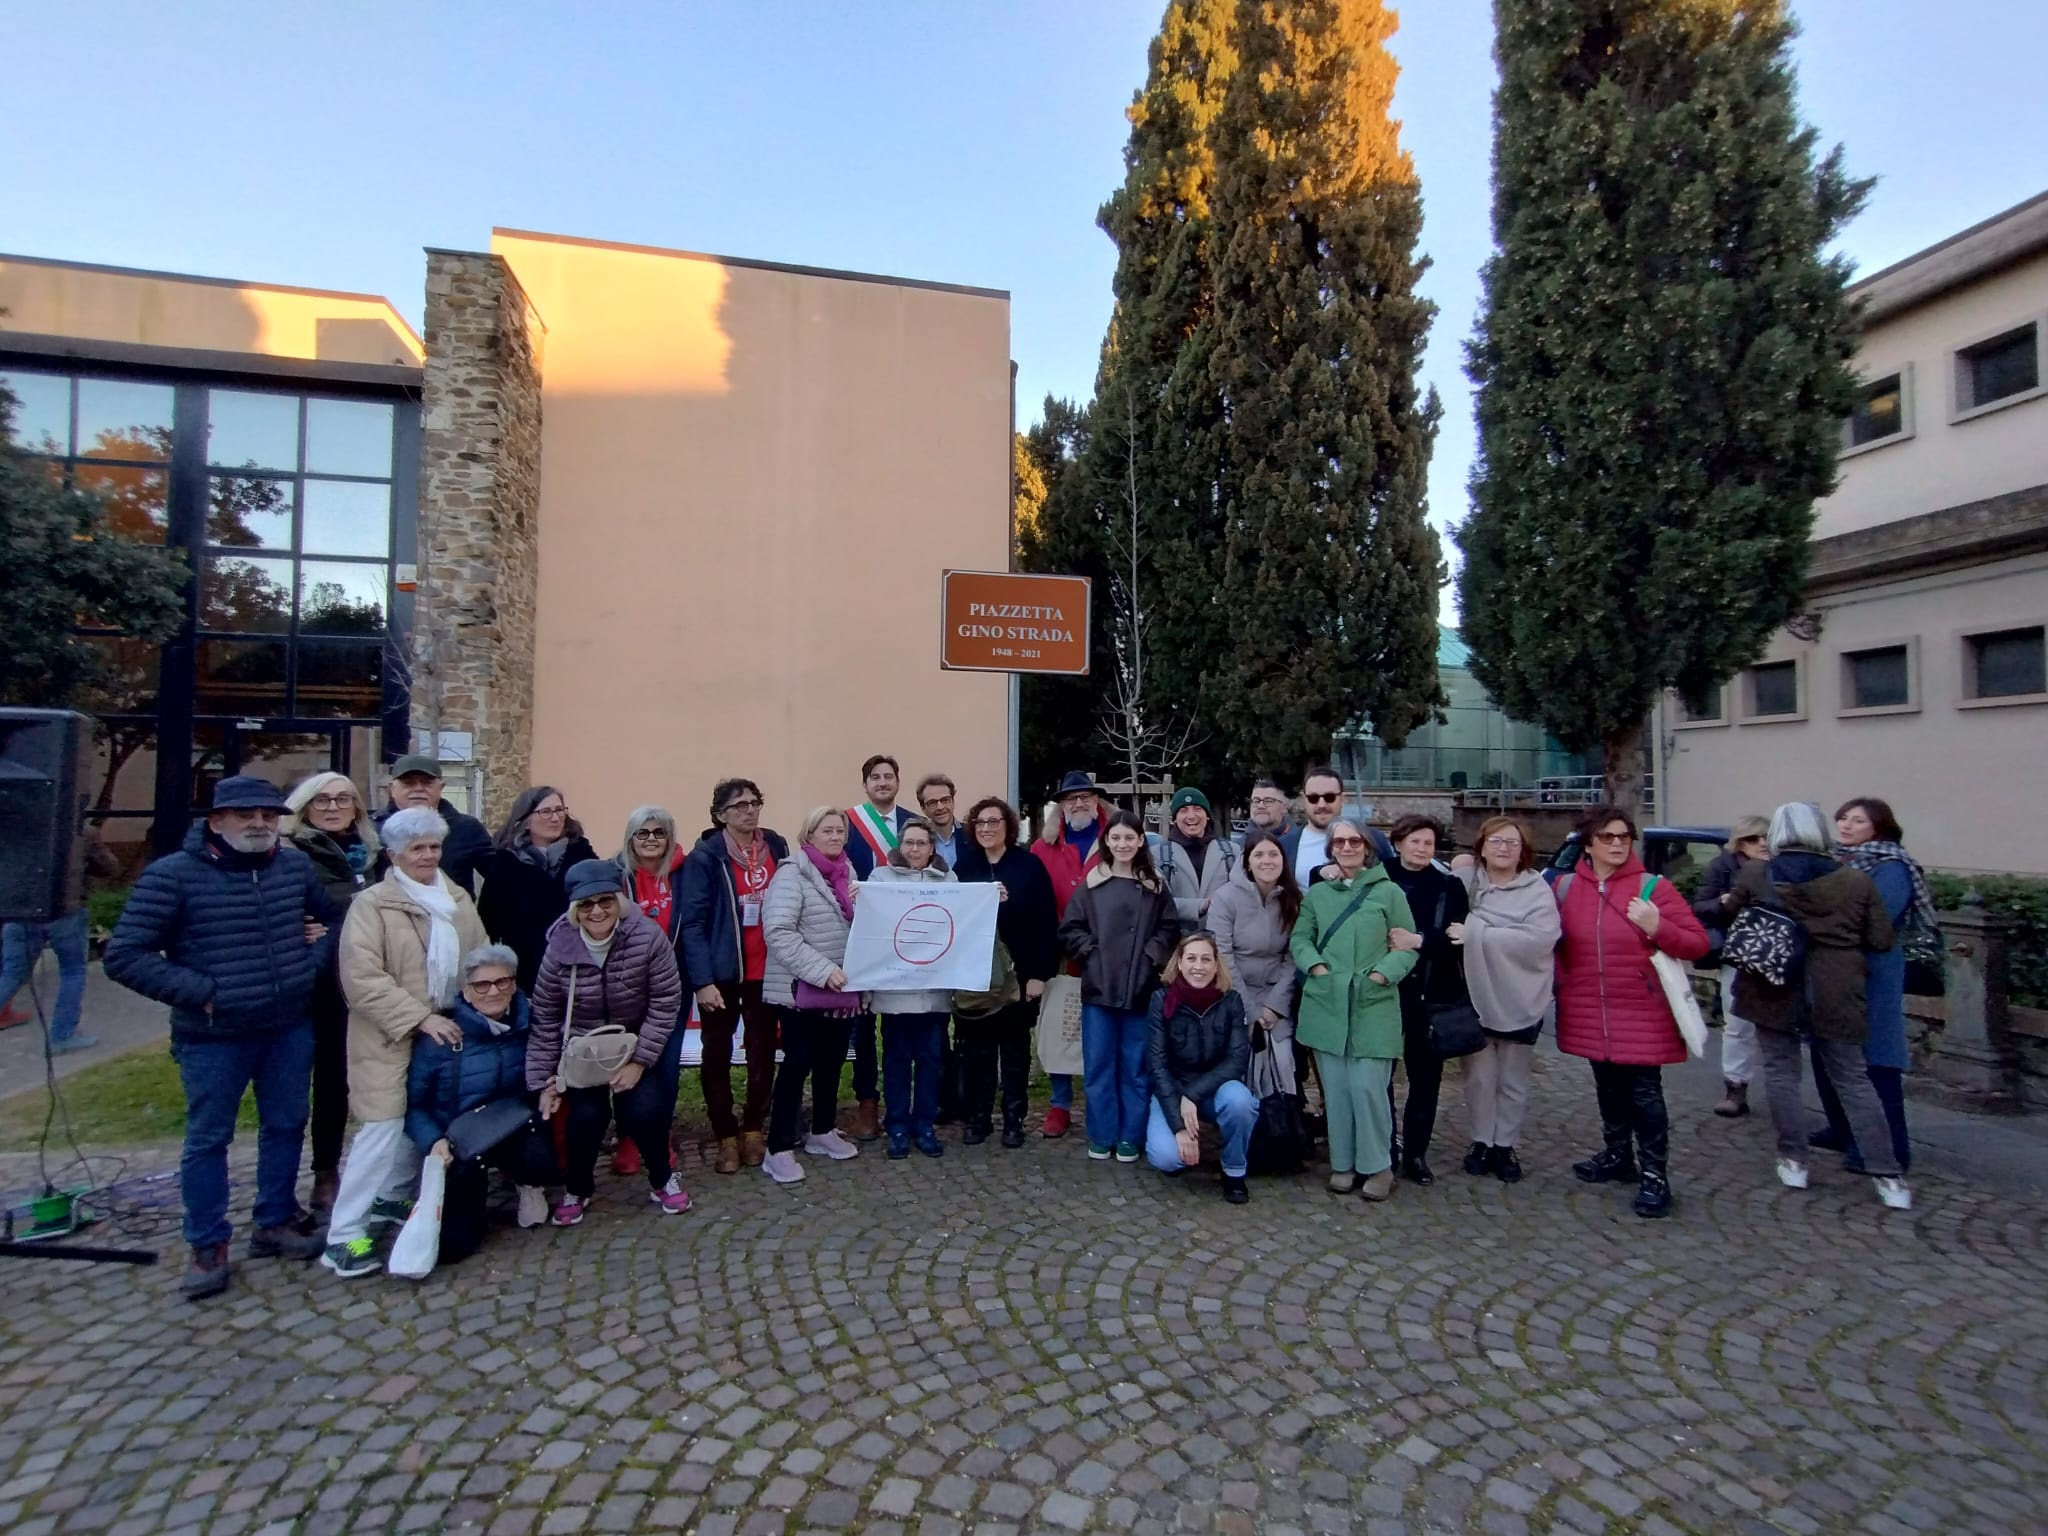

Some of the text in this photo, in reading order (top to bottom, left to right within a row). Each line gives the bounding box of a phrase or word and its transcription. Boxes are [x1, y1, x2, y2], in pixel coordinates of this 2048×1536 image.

[970, 603, 1064, 620] PIAZZETTA
[958, 624, 1073, 642] GINO STRADA
[992, 648, 1012, 657] 1948
[1020, 649, 1041, 658] 2021
